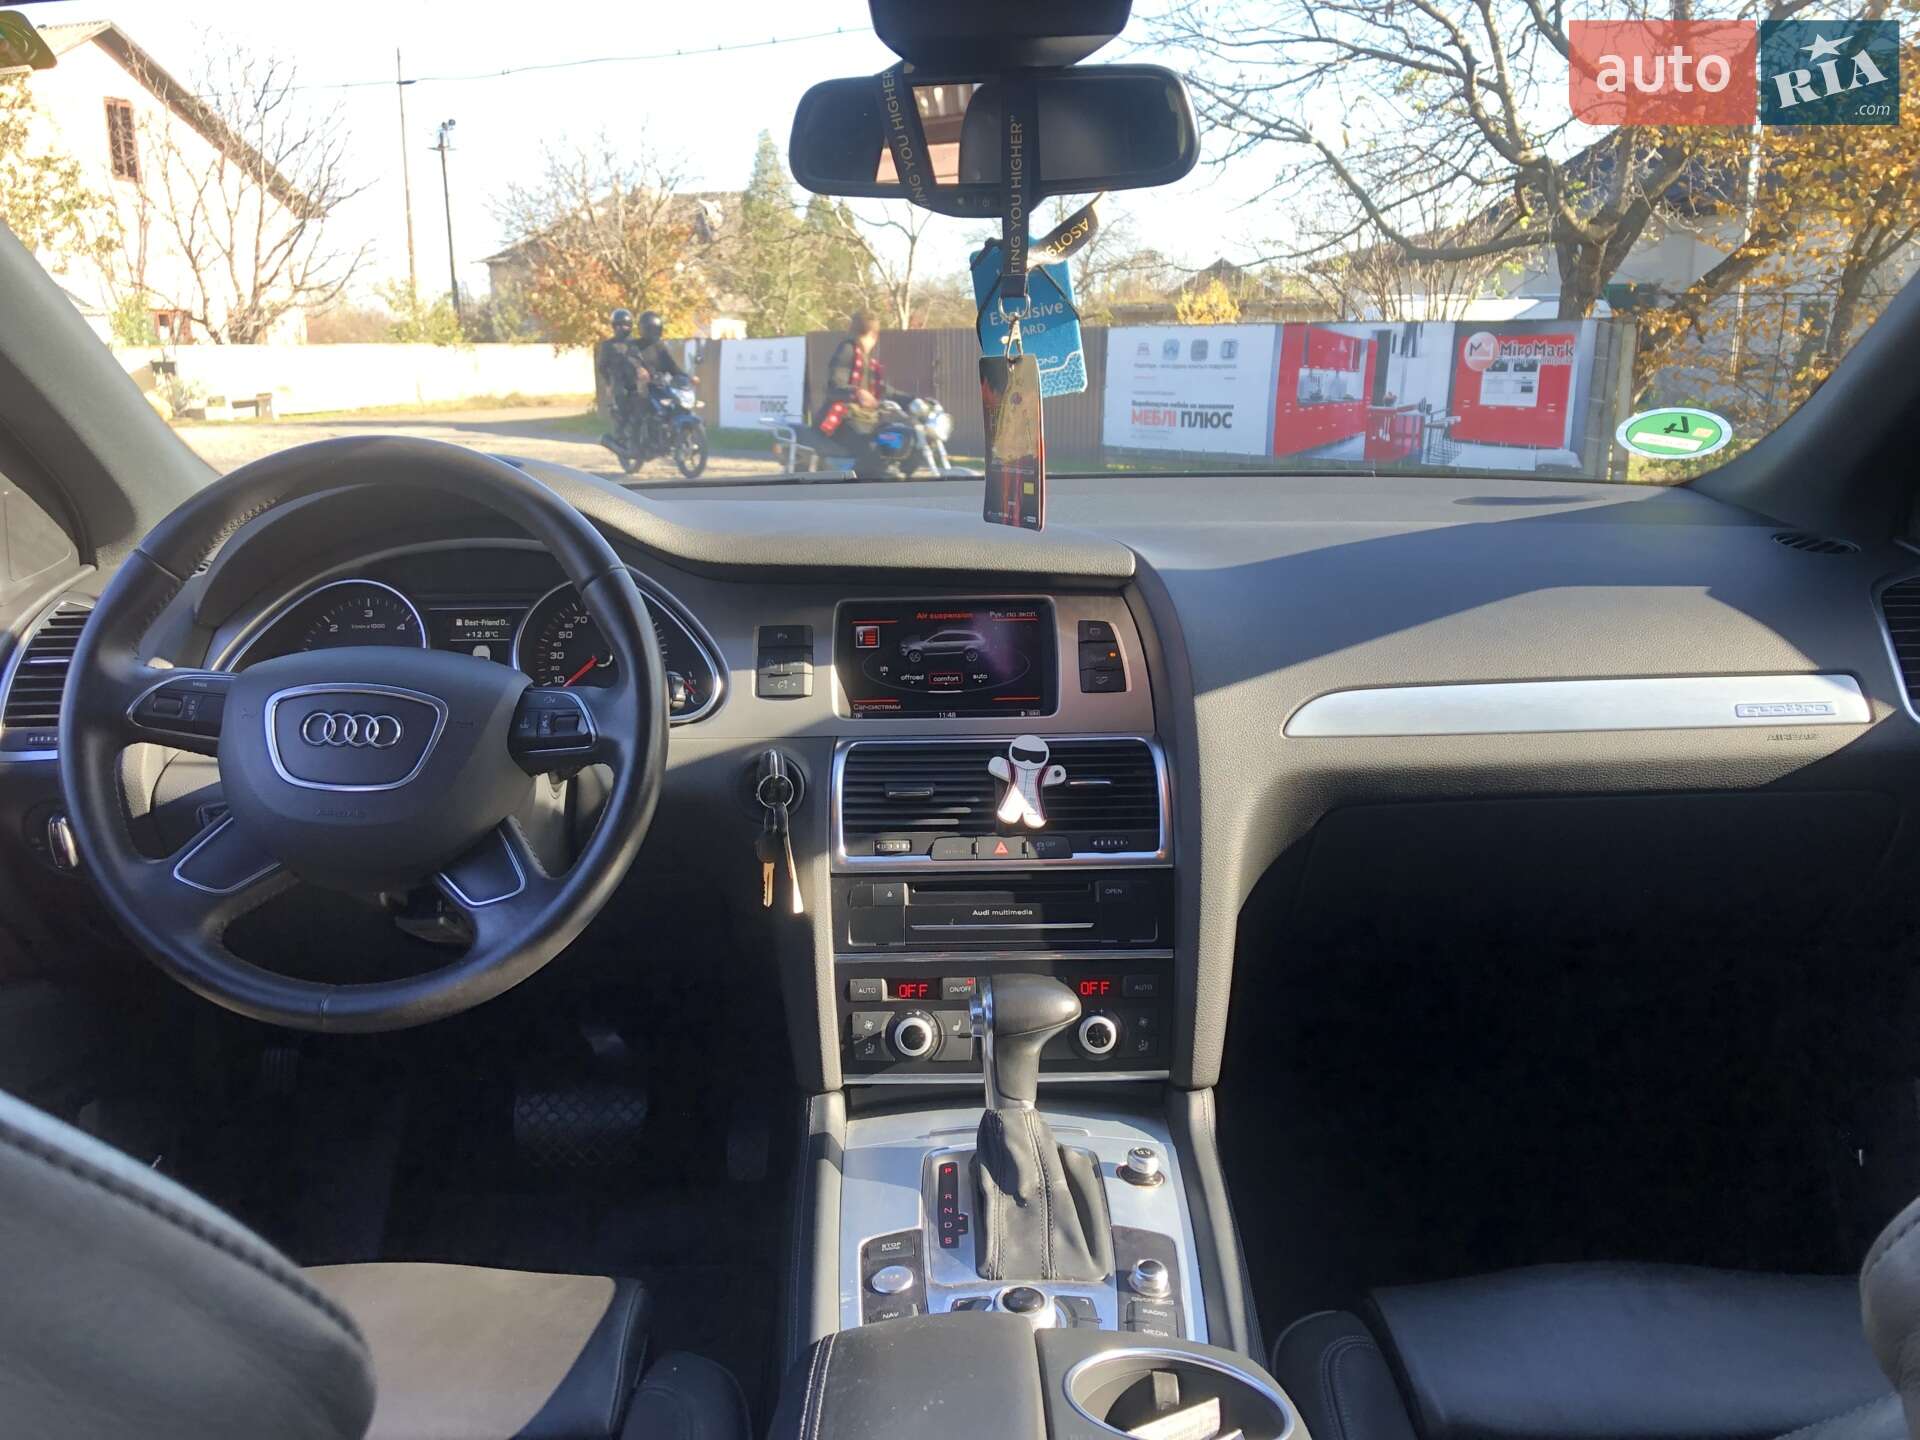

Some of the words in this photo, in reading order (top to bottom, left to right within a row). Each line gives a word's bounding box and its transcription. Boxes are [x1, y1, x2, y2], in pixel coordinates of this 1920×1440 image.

[896, 135, 915, 170] YOU
[1010, 194, 1021, 232] YOU
[1500, 342, 1574, 358] MiroMark
[1131, 408, 1177, 428] МЕБЛІ
[1180, 411, 1233, 429] ПЛЮС
[364, 609, 373, 618] 3
[573, 616, 588, 624] 70
[329, 624, 338, 632] 2
[396, 623, 405, 631] 4
[558, 631, 573, 639] 50
[899, 983, 928, 998] OFF
[949, 985, 971, 993] ON/OFF
[1080, 981, 1110, 995] OFF
[882, 1311, 900, 1319] NAV
